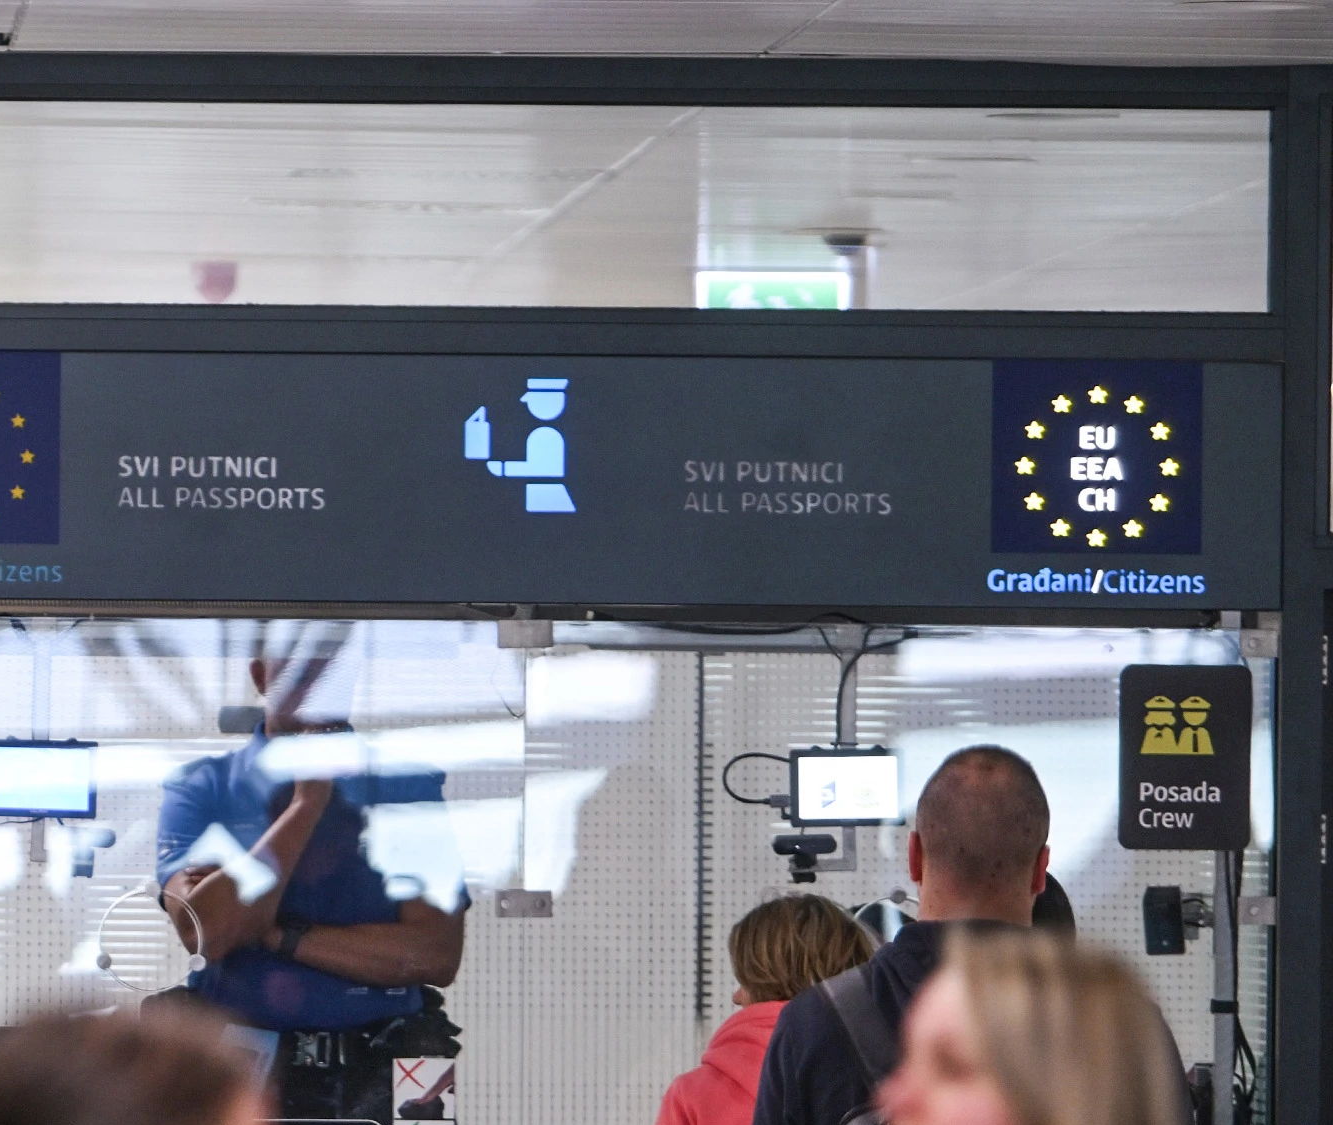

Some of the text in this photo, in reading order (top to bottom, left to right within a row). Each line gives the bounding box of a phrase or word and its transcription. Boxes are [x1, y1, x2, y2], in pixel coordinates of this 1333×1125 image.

[1079, 426, 1117, 450] EU
[119, 456, 276, 478] SVI PUTNICI
[685, 460, 842, 483] SVI PUTNICI
[1070, 457, 1124, 481] EEA
[119, 487, 324, 509] ALL PASSPORTS
[685, 493, 891, 514] ALL PASSPORTS
[1078, 488, 1117, 511] CH
[987, 568, 1205, 594] Građani/Citizens
[1140, 781, 1220, 802] Posada
[1139, 808, 1193, 828] Crew
